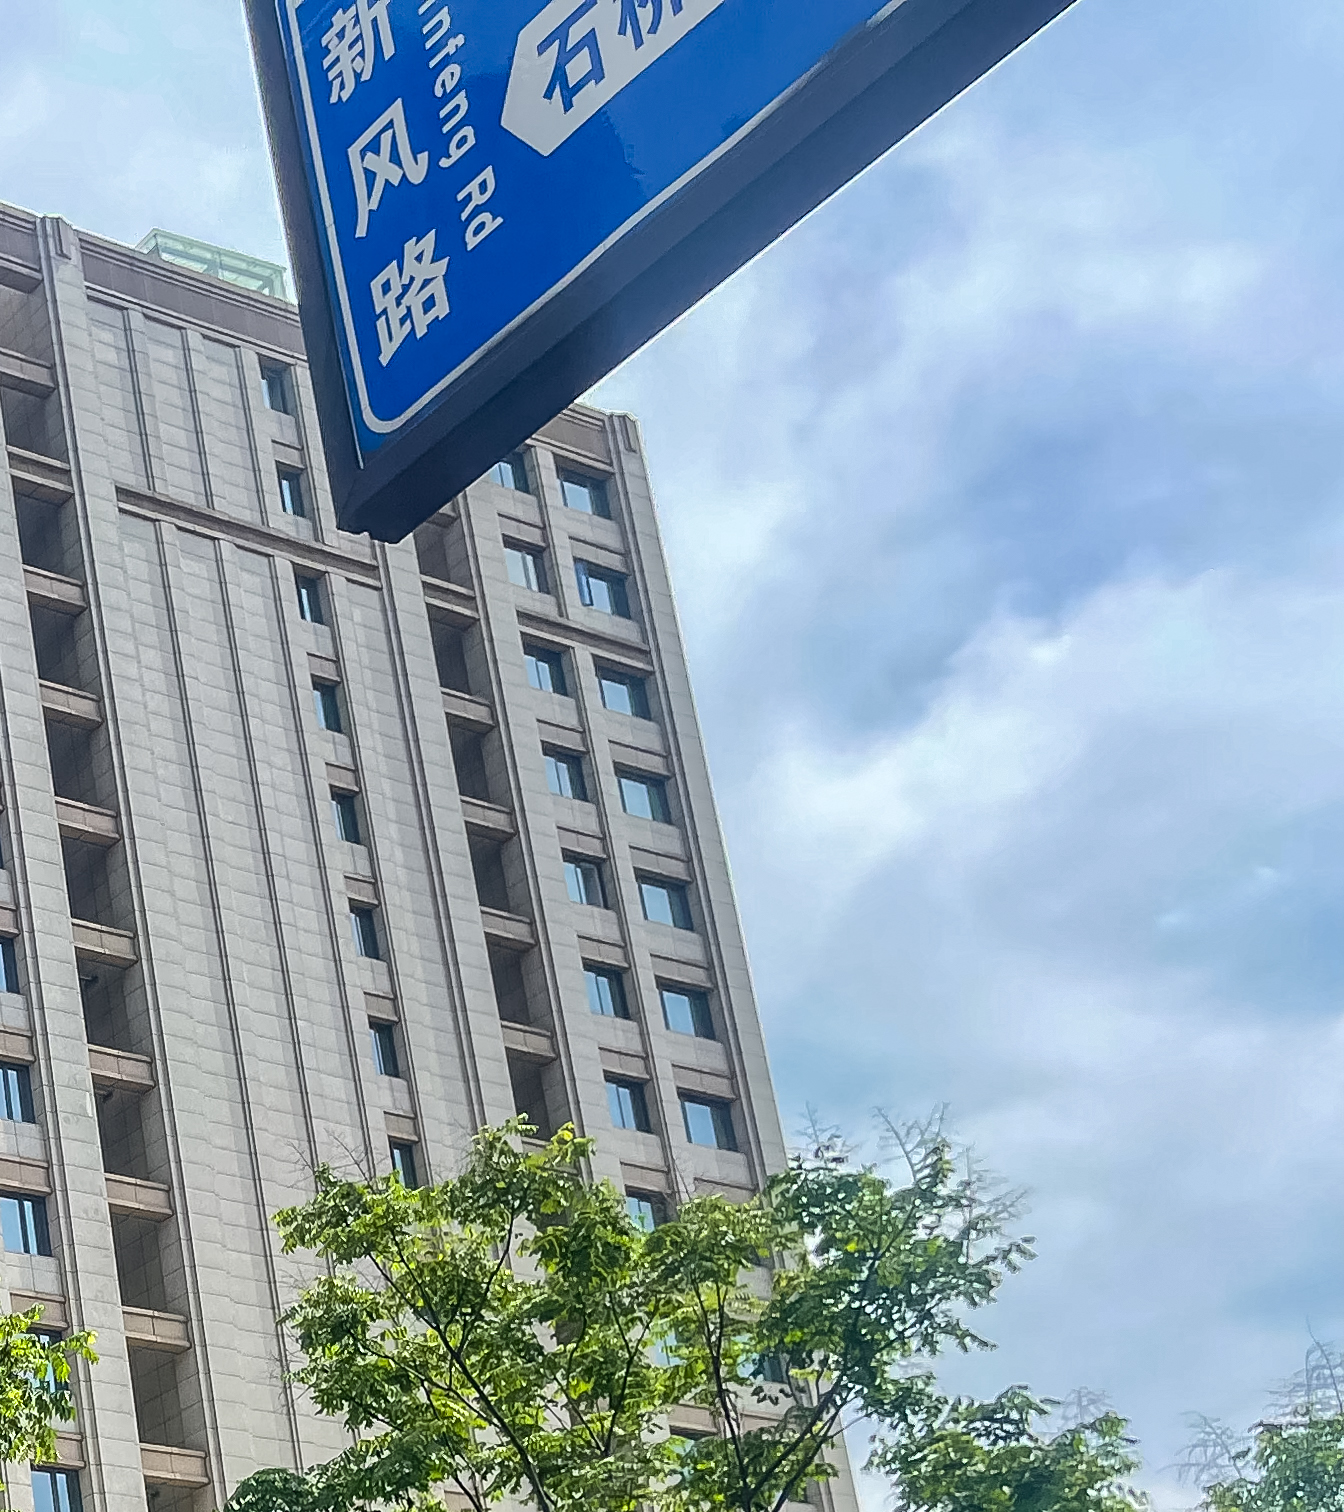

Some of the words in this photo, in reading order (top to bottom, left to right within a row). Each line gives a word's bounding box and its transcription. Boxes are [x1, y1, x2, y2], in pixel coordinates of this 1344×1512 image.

[321, 0, 450, 367] 新风路
[456, 165, 505, 251] Rd
